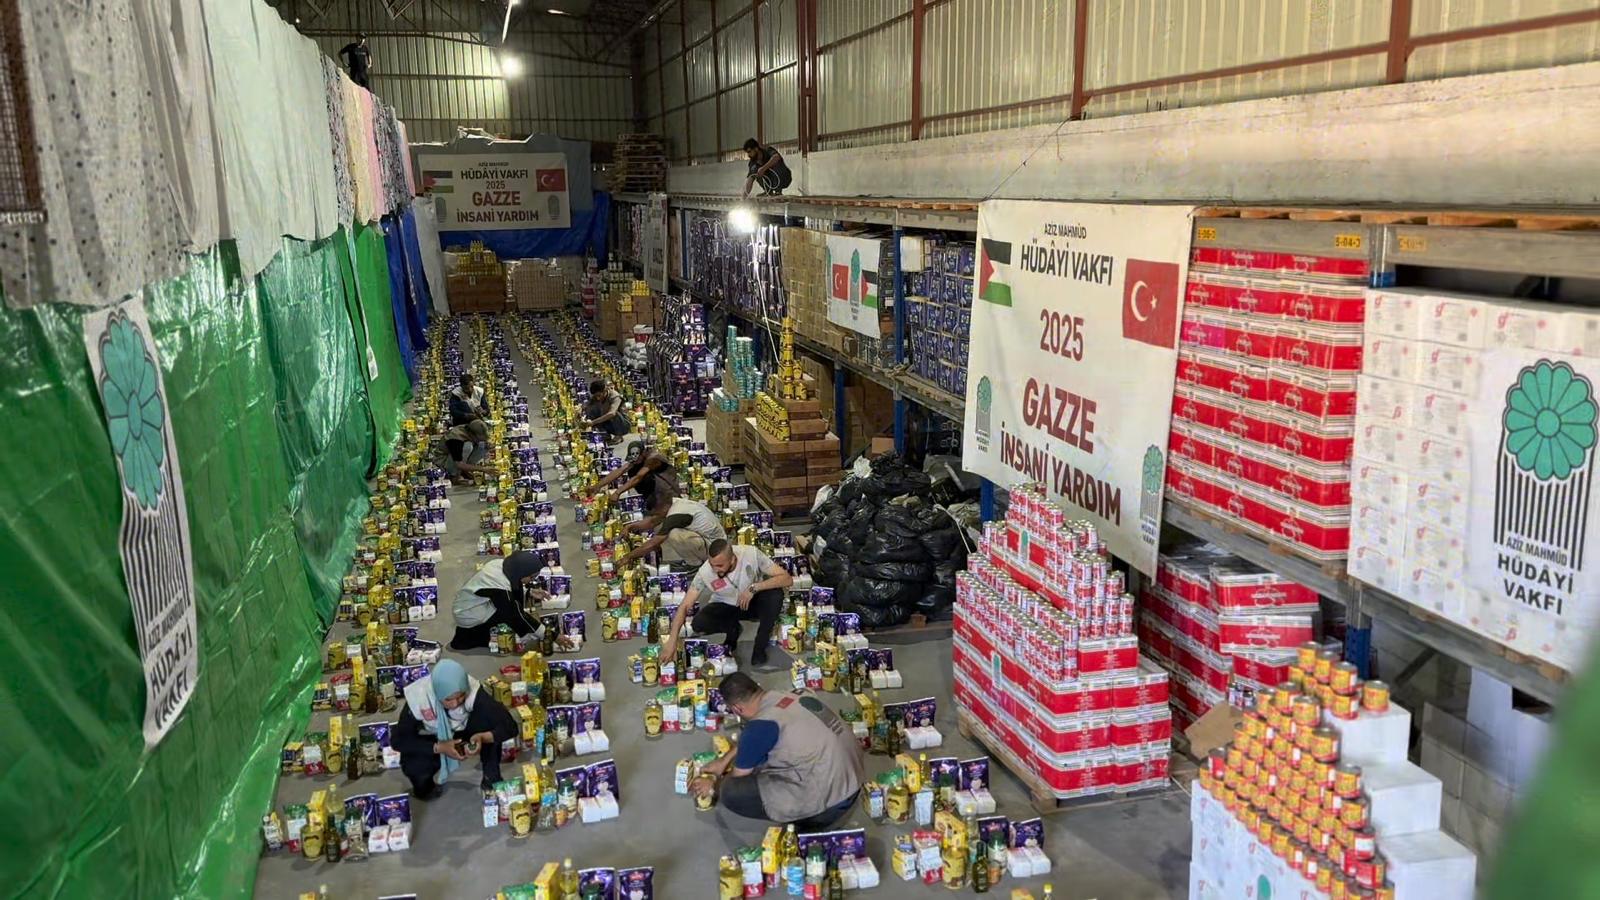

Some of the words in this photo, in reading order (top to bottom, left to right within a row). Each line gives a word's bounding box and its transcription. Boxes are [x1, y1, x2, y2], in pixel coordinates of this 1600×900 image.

[461, 168, 497, 180] HÜDÂYİ
[499, 169, 528, 179] VAKFI
[486, 181, 506, 190] 2025
[457, 208, 494, 223] İNSANİ
[496, 210, 539, 222] YARDIM
[472, 191, 521, 207] GAZZE
[1020, 237, 1070, 278] HÜDÂYİ
[1072, 250, 1114, 286] VAKFI
[1040, 308, 1085, 362] 2025
[1022, 377, 1097, 455] GAZZE
[1000, 421, 1050, 483] İNSANİ
[1052, 456, 1121, 527] YARDIM
[1498, 553, 1573, 594] HÜDÂYİ
[1504, 578, 1562, 615] VAKFI
